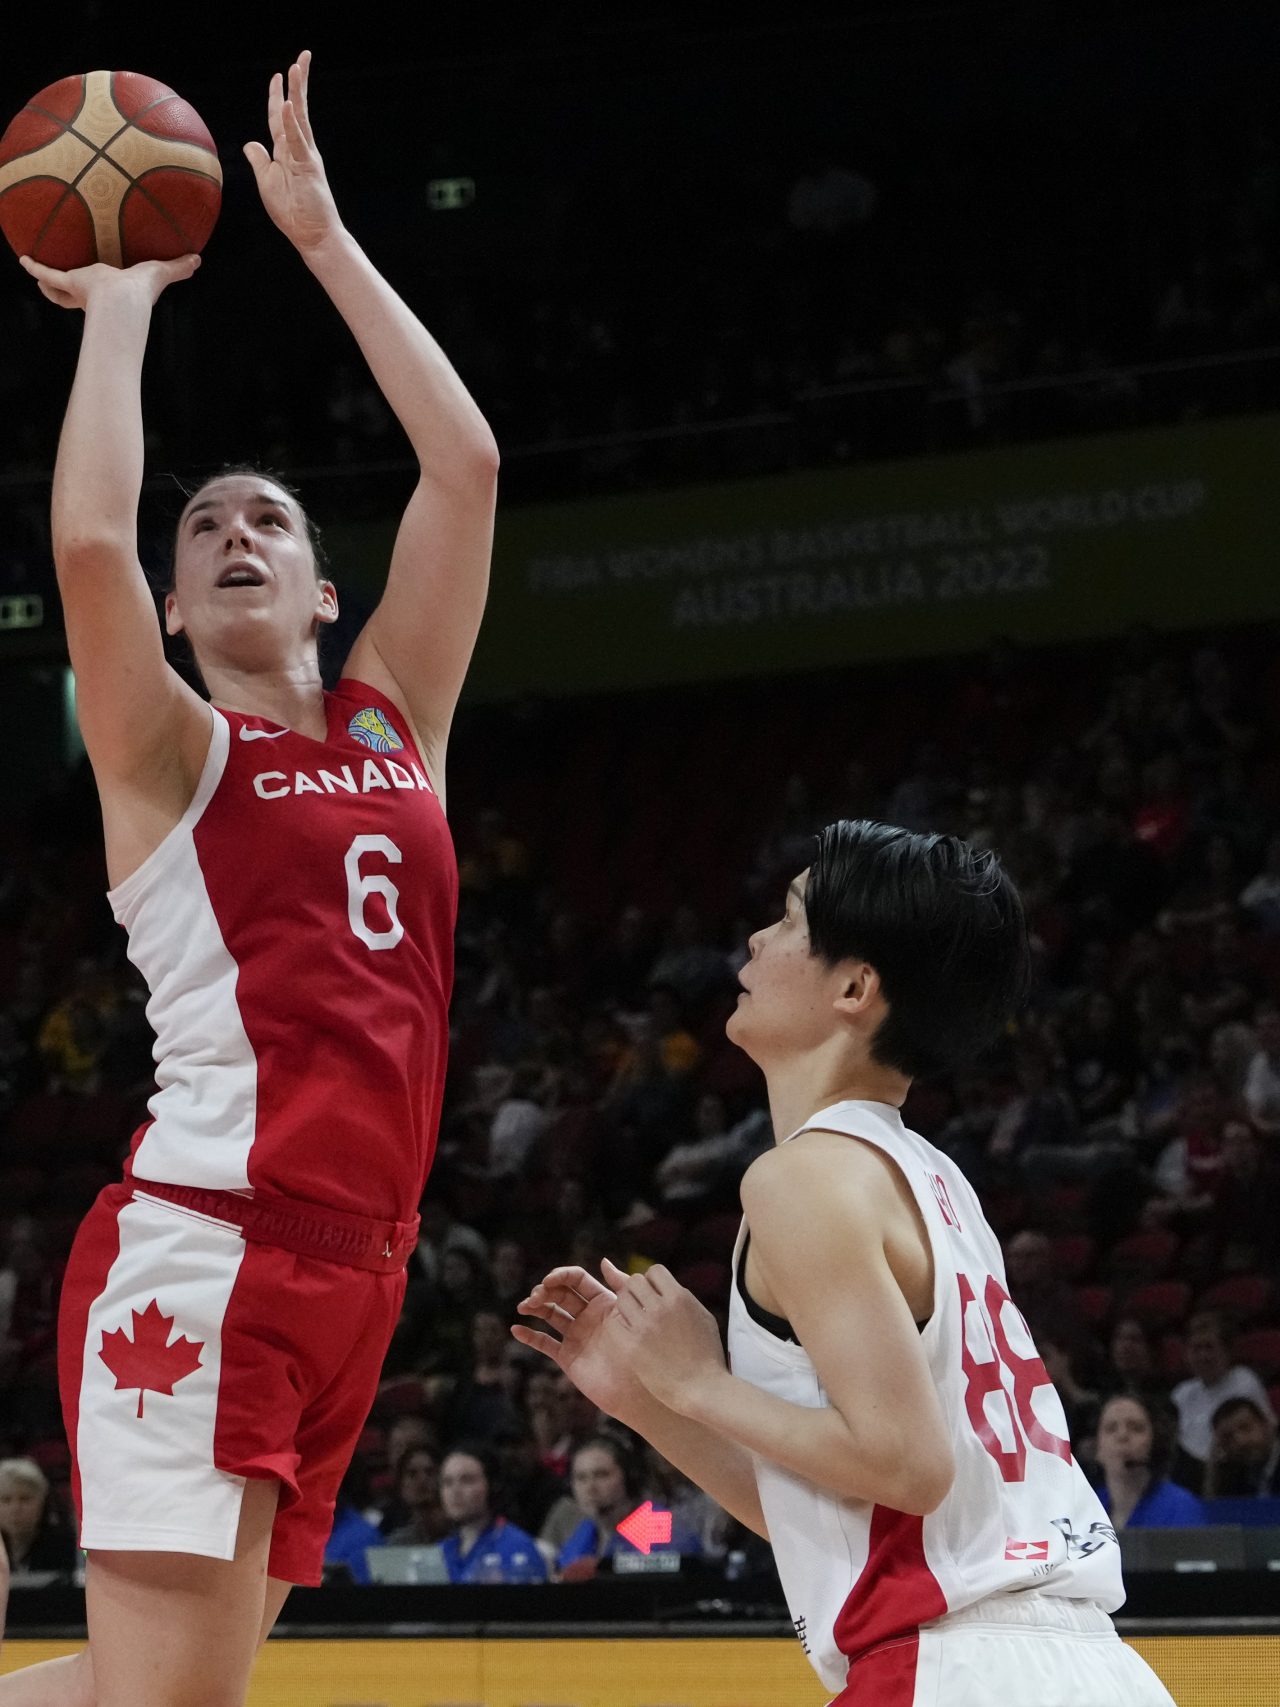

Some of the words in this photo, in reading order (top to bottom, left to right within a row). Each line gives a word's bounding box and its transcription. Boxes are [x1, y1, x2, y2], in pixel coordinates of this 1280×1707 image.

[772, 511, 991, 563] BASKETBALL
[998, 489, 1128, 535] WORLD
[1133, 479, 1206, 517] CUP
[673, 561, 924, 628] AUSTRALIA
[934, 545, 1051, 599] 2022
[252, 758, 433, 800] CANADA
[344, 834, 404, 951] 6
[956, 1272, 1073, 1483] 88
